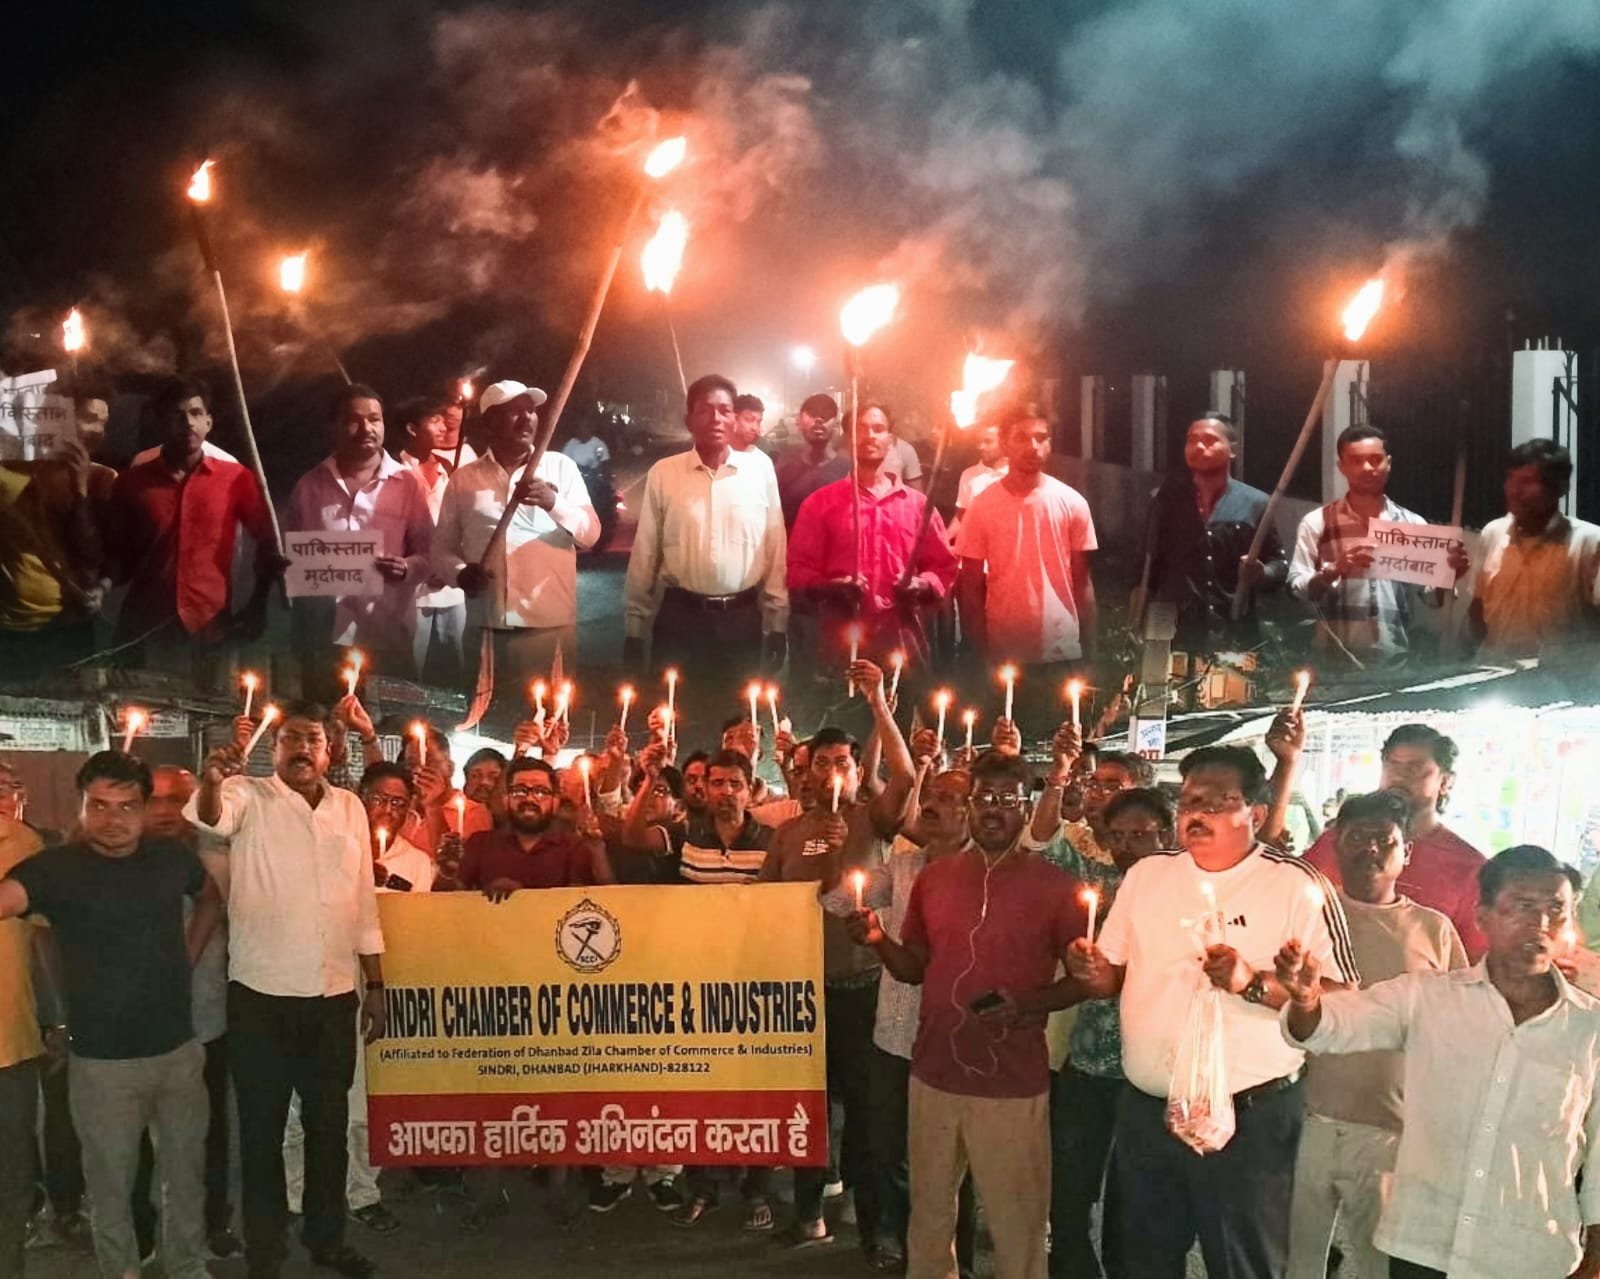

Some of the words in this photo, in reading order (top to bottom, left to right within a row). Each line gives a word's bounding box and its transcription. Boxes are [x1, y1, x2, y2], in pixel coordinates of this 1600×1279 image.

[291, 538, 377, 556] पाकिस्तान
[1374, 527, 1454, 551] पाकिस्तान
[377, 987, 437, 1039] INDRI
[441, 985, 533, 1038] CHAMBER
[538, 983, 562, 1036] OF
[567, 982, 675, 1036] COMMERCE
[681, 981, 696, 1034] &
[701, 979, 817, 1034] INDUSTRIES
[380, 1047, 435, 1061] (Affiliated
[437, 1047, 450, 1059] to
[452, 1047, 509, 1060] Federation
[513, 1046, 526, 1058] of
[528, 1046, 579, 1059] Dhanbad
[581, 1045, 602, 1056] Zila
[604, 1044, 657, 1056] Chamber
[659, 1044, 672, 1056] of
[673, 1043, 735, 1056] Commerce
[737, 1043, 748, 1055] &
[751, 1042, 813, 1056] Industries)
[477, 1064, 520, 1077] SINDRI,
[522, 1063, 580, 1076] DHANBAD
[388, 1121, 477, 1157] आपका
[482, 1104, 569, 1160] हार्दिक
[575, 1103, 698, 1156] अभिनंदन
[704, 1118, 781, 1155] करता
[786, 1101, 811, 1158] है
